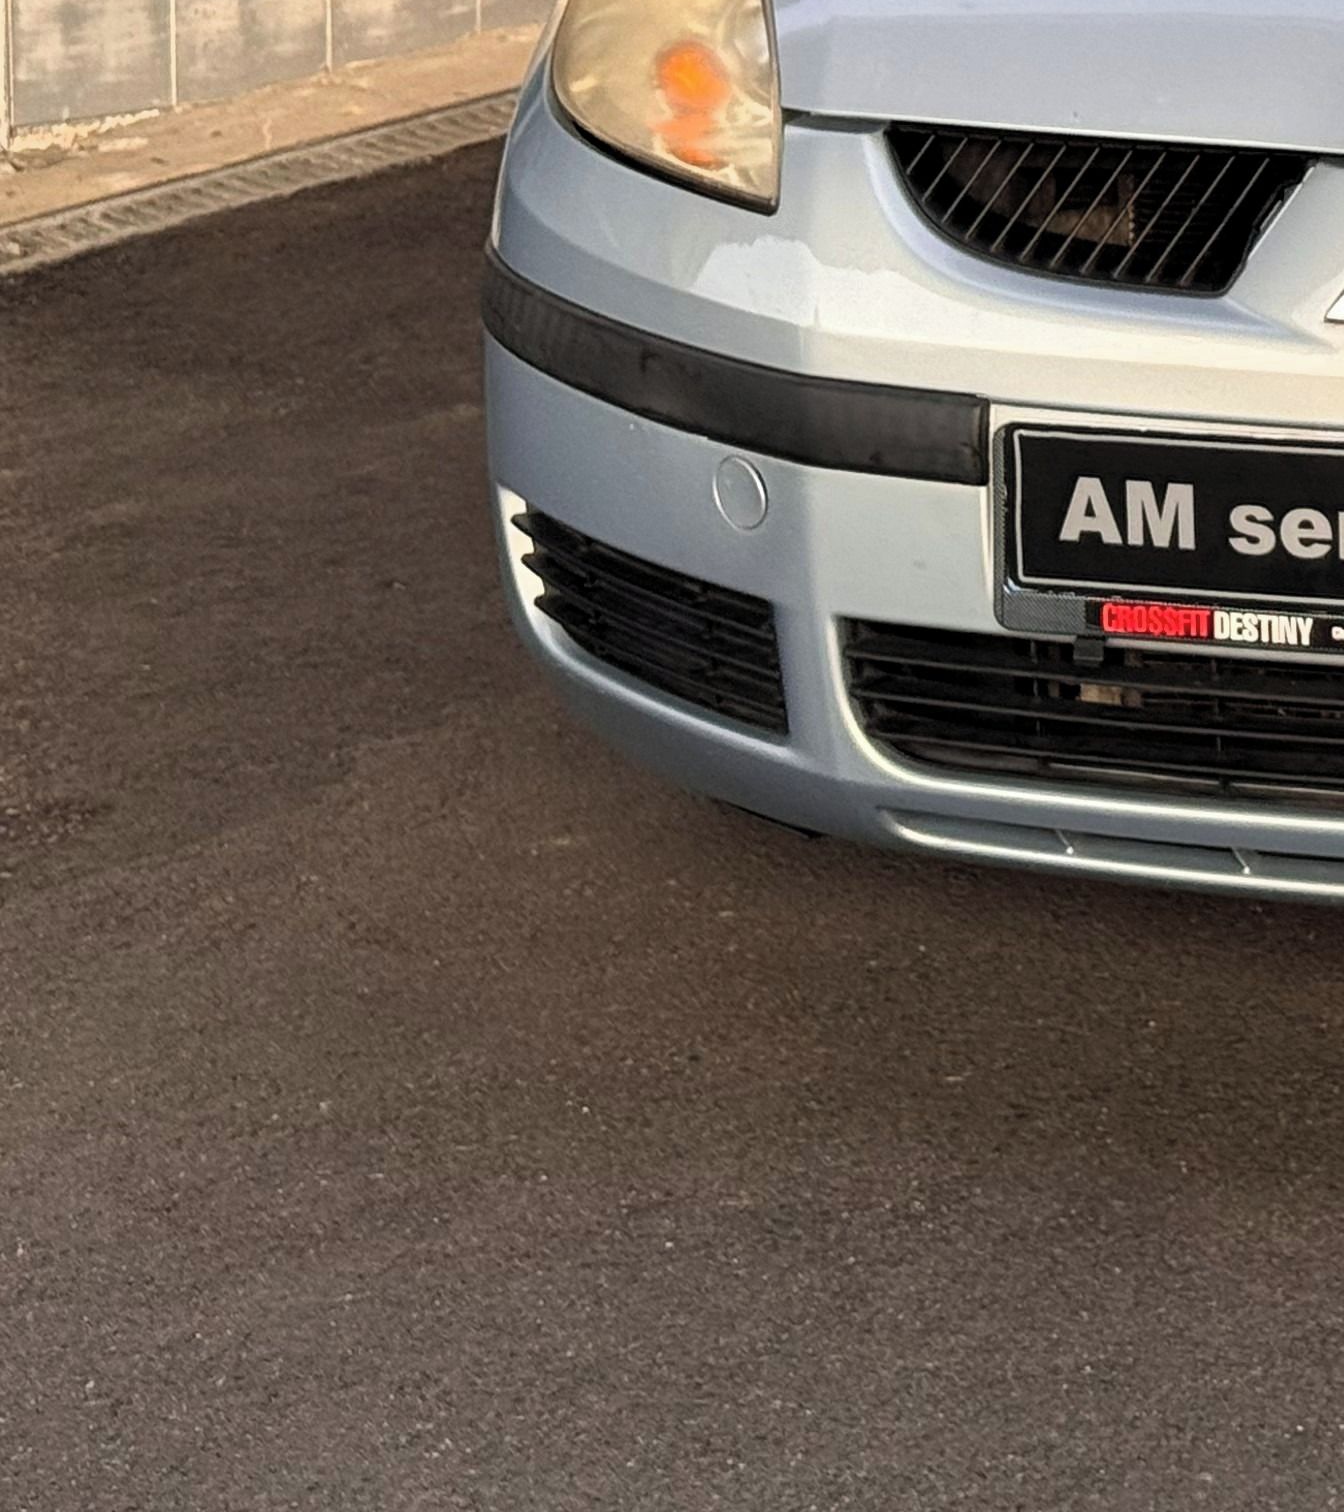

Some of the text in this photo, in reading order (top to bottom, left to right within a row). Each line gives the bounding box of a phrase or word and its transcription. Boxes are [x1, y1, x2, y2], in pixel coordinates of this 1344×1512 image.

[1059, 476, 1196, 551] AM
[1103, 603, 1211, 637] CROSSFIT
[1213, 610, 1313, 646] DESTINY
